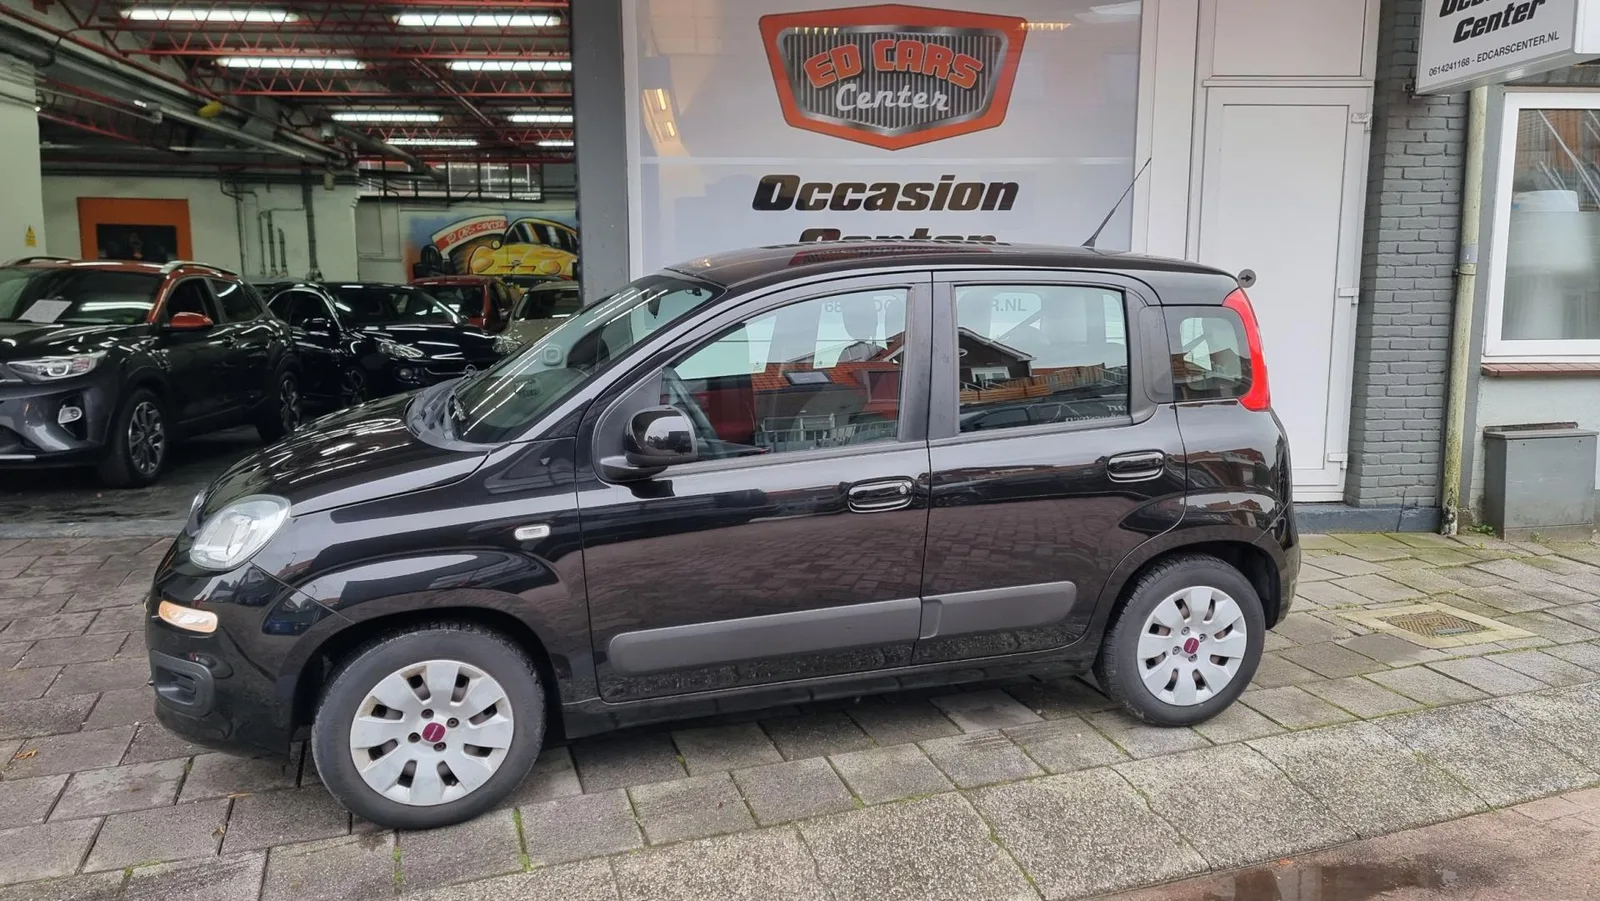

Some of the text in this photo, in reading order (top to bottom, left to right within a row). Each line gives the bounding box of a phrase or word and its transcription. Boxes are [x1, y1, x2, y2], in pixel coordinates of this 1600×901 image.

[1453, 0, 1546, 43] Center
[804, 39, 983, 89] ED CARS
[1428, 57, 1470, 77] 0614241168
[1477, 31, 1560, 63] EDCARSCENTER.NL
[835, 83, 949, 111] Center
[752, 174, 1020, 211] Occasion
